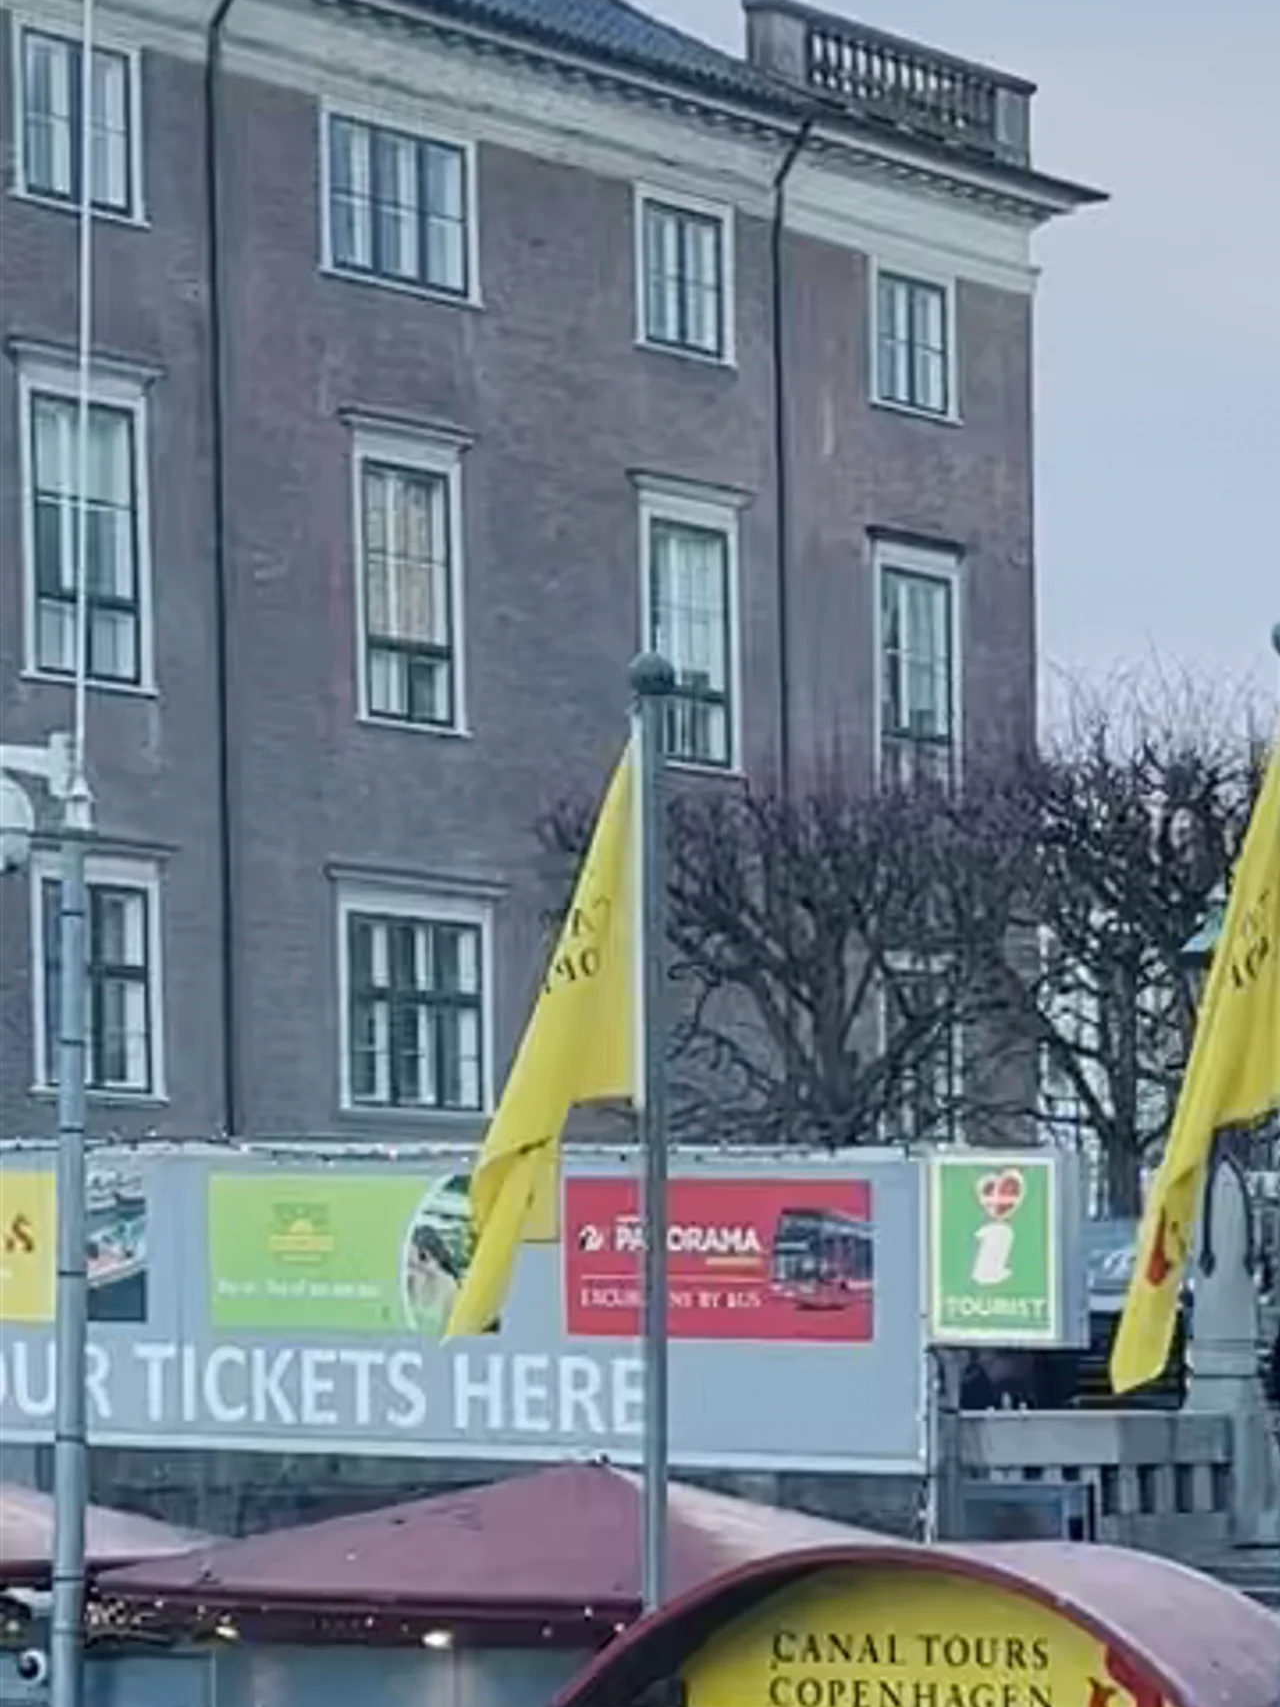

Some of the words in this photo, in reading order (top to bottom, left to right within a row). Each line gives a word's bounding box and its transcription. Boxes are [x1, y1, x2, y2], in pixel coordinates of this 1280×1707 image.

[615, 1224, 763, 1253] PAORAMA
[699, 1290, 723, 1309] BY
[945, 1295, 1046, 1320] TOURIST
[0, 1340, 112, 1419] UR
[134, 1342, 427, 1428] TICKETS
[453, 1353, 646, 1434] HERE
[772, 1629, 906, 1666] CANAL
[917, 1633, 1050, 1671] TOURS
